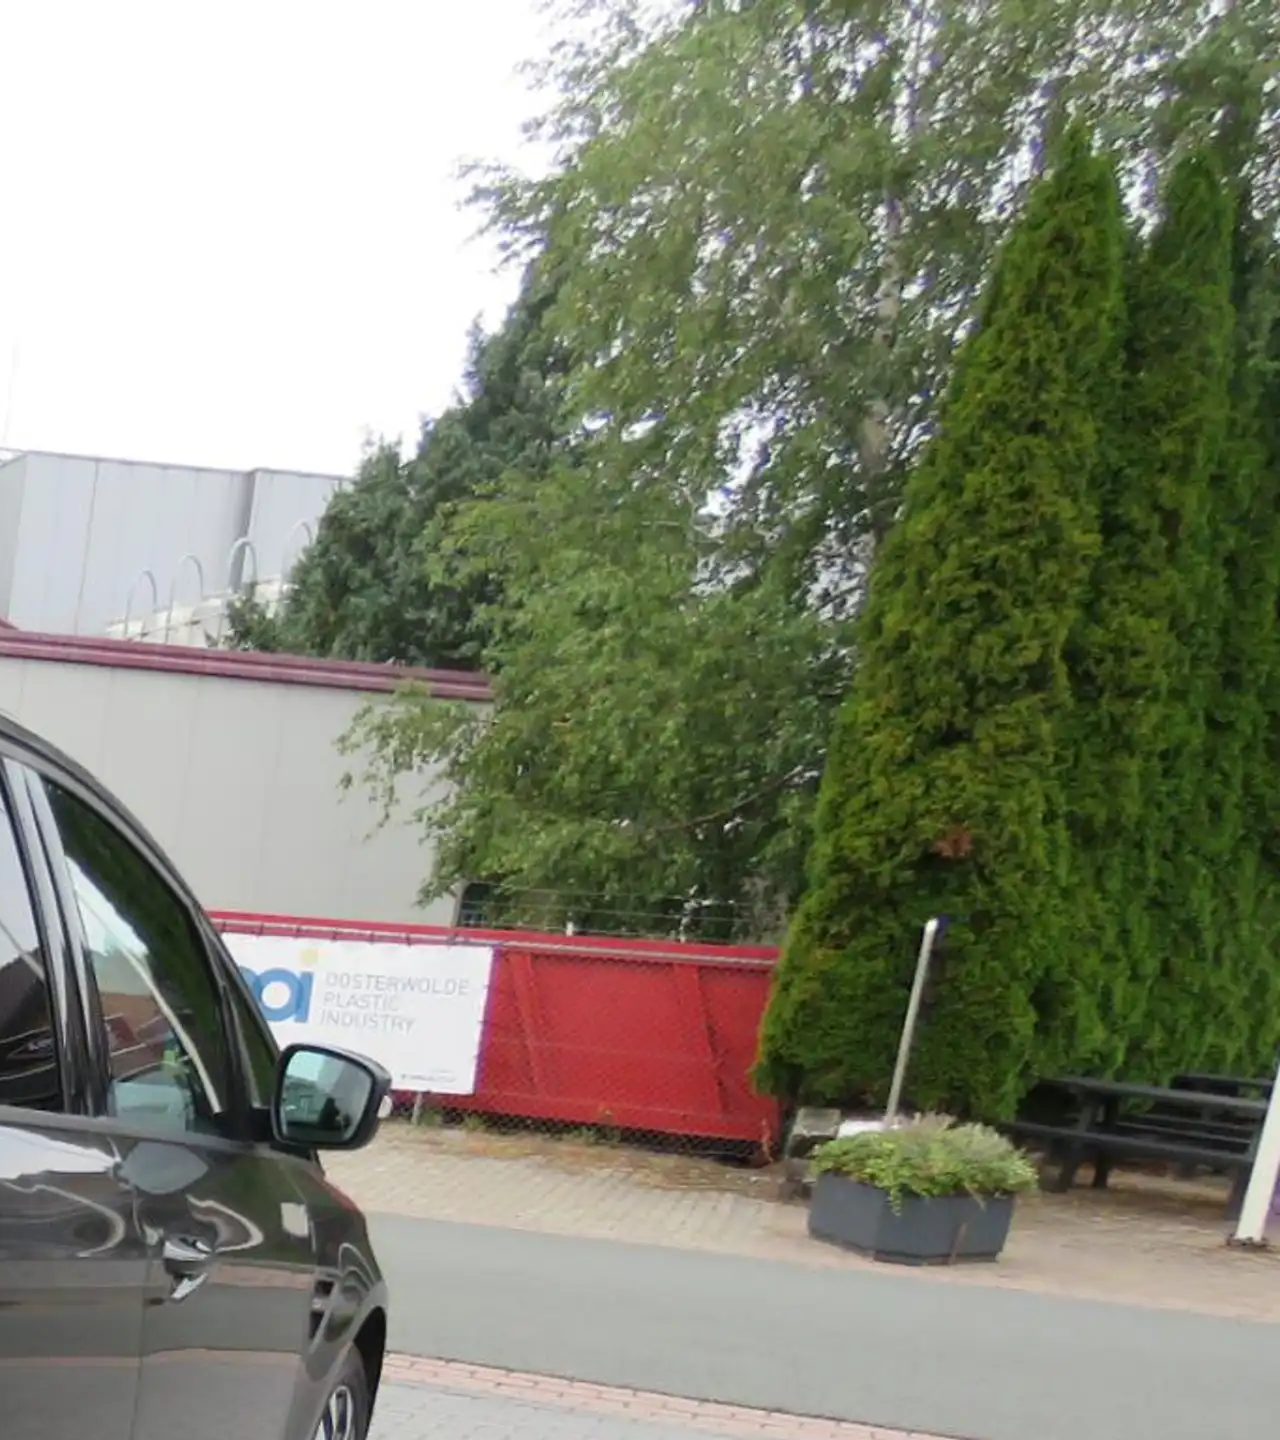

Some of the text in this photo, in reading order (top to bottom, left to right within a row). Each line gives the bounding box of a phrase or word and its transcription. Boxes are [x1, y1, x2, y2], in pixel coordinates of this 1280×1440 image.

[324, 971, 471, 996] OOSTERWOLDE
[322, 991, 401, 1012] PLASTIC
[319, 1009, 416, 1036] INDUSTRY
